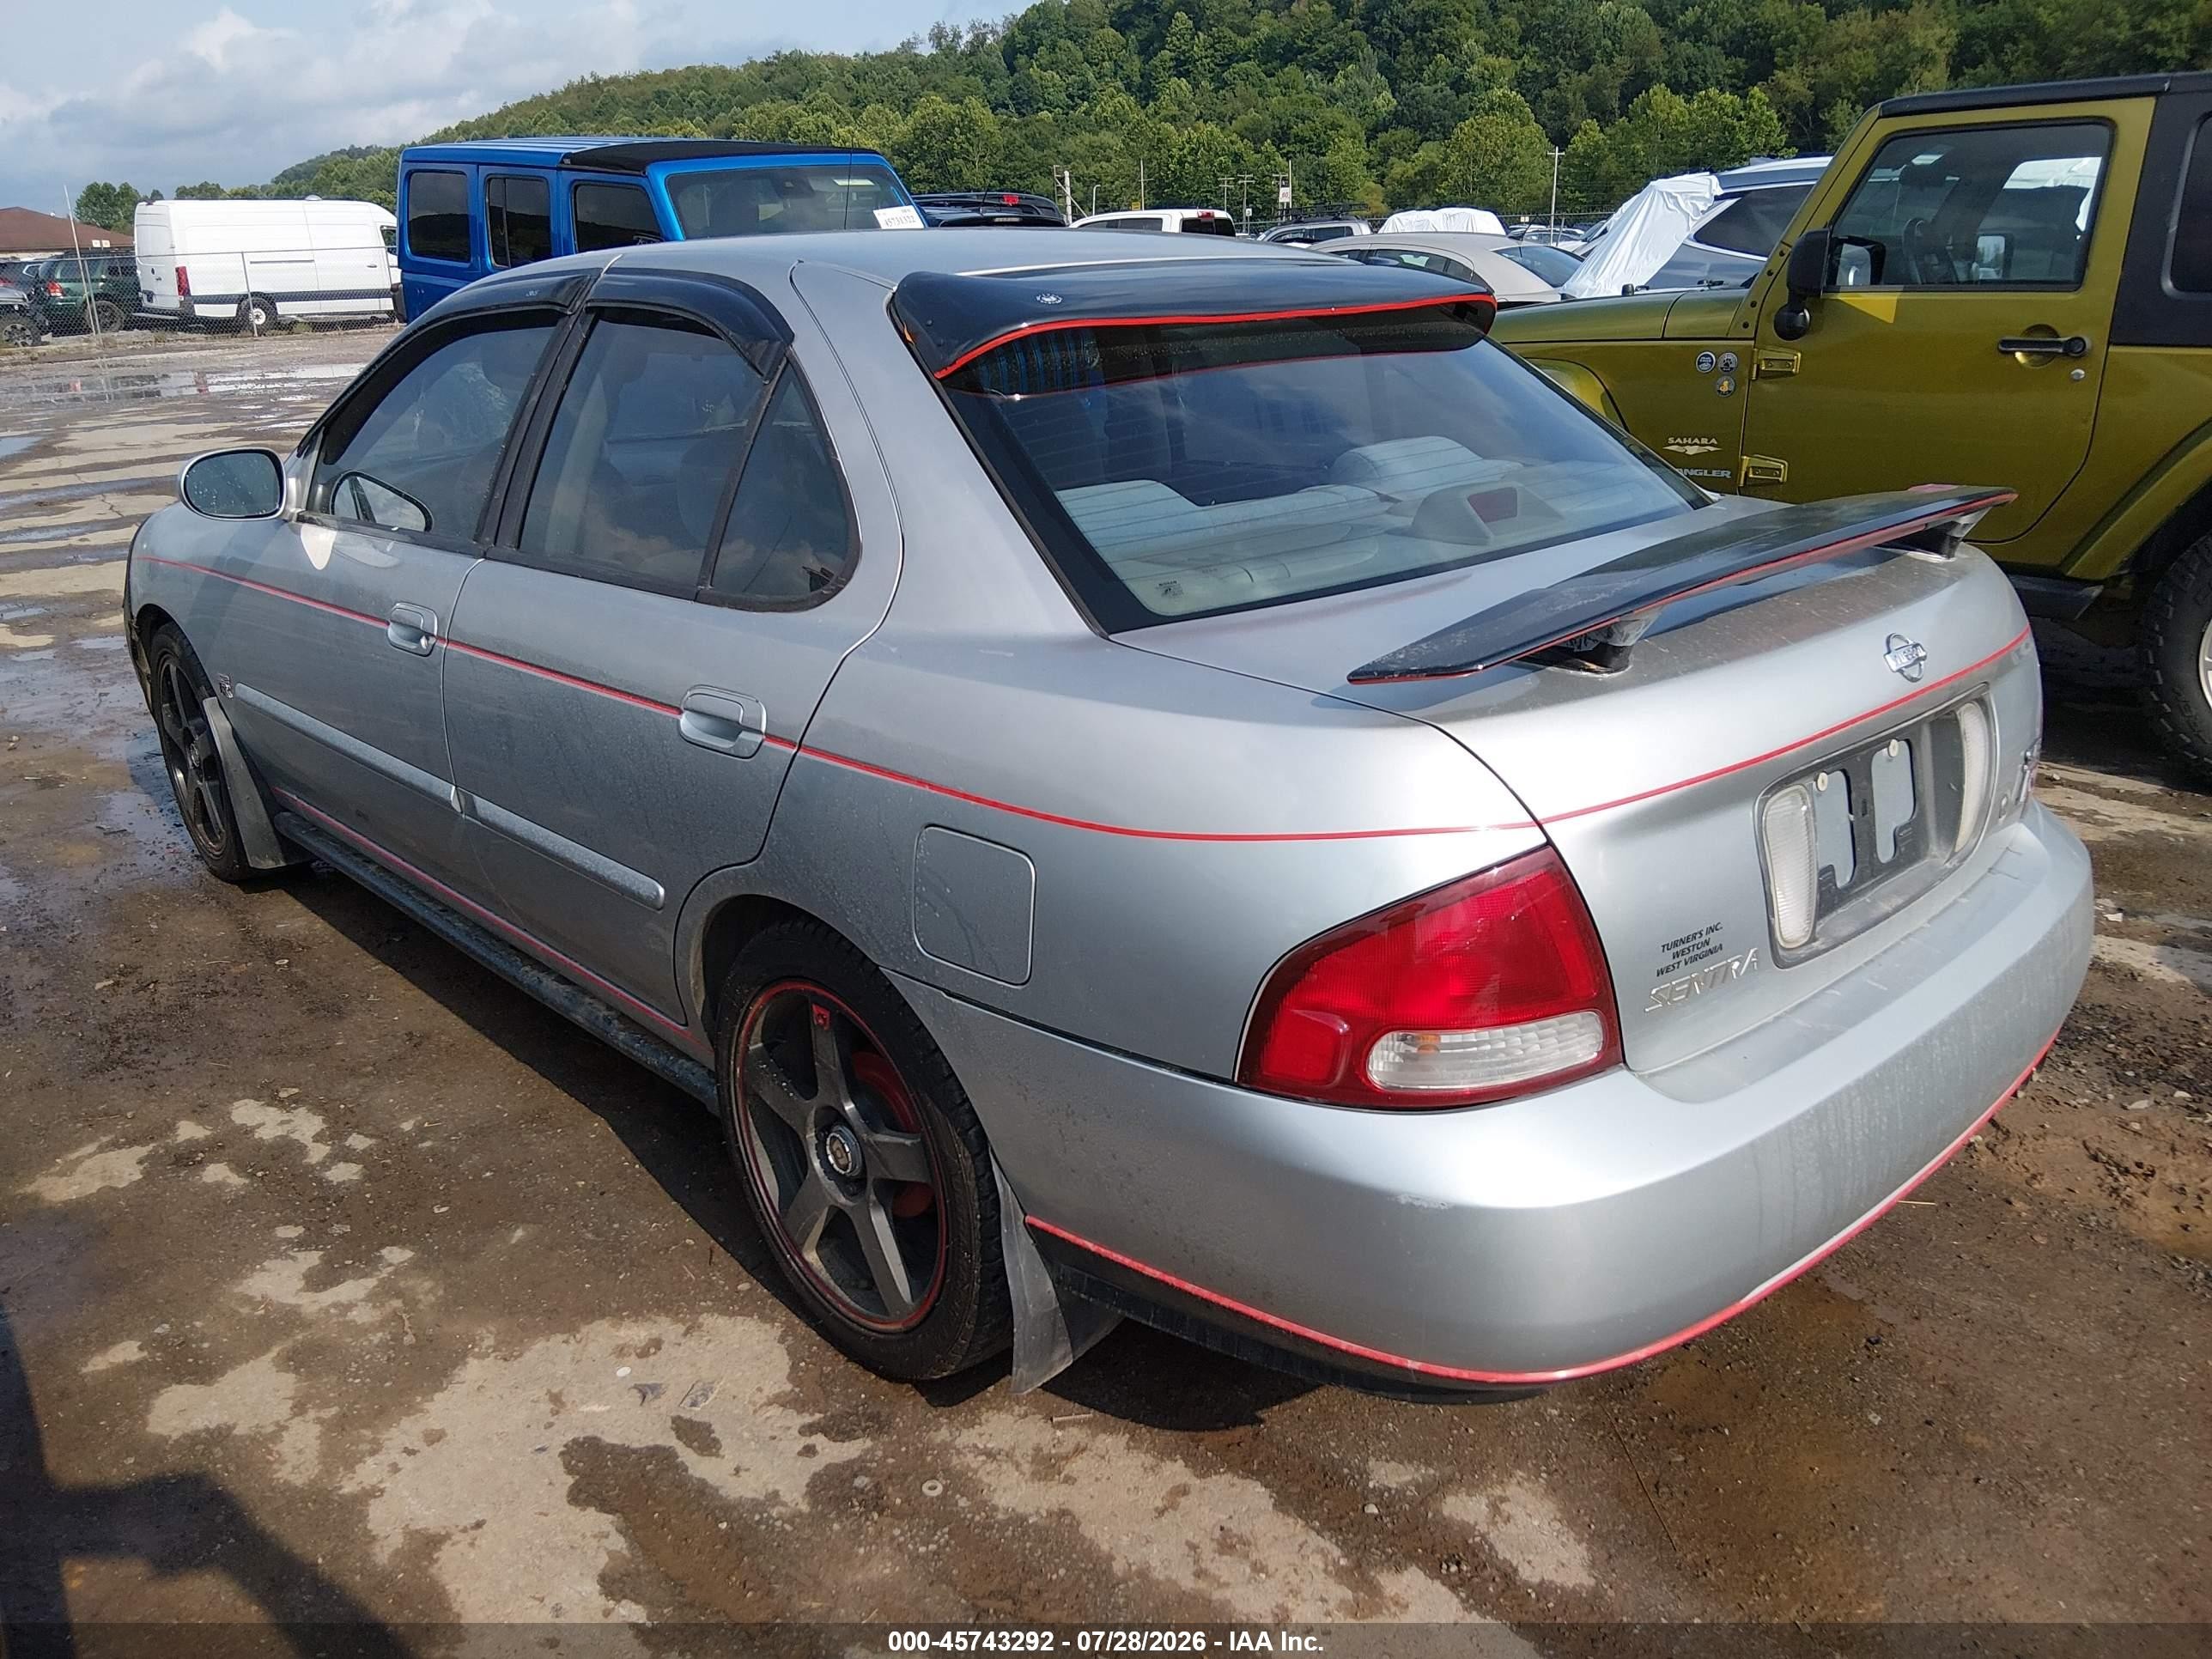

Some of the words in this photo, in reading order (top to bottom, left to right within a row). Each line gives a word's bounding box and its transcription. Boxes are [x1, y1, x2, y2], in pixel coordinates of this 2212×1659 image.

[1661, 930, 1704, 952] TURNER'S
[1705, 921, 1723, 936] INC.
[1672, 937, 1711, 959] WESTON
[1656, 960, 1683, 977] WEST
[1683, 943, 1723, 967] VIRGINIA
[1644, 948, 1758, 1012] SENTRA
